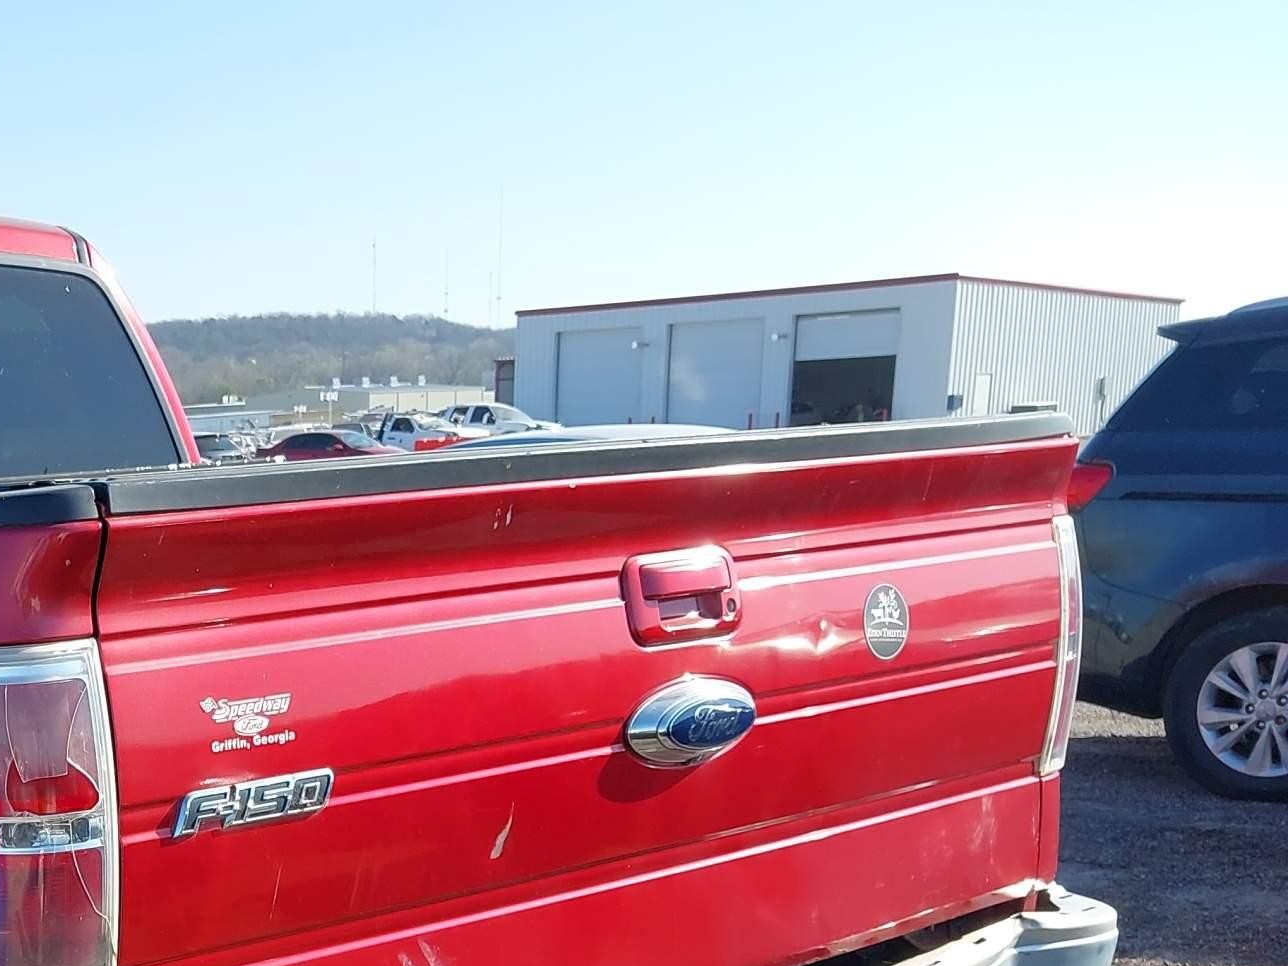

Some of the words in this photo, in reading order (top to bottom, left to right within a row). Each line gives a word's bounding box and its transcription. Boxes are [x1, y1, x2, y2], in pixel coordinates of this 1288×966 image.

[212, 693, 292, 723] Speedway
[688, 704, 740, 742] Ford
[211, 738, 251, 753] Griffin,
[253, 730, 296, 747] Georgia
[173, 767, 335, 841] F-150
